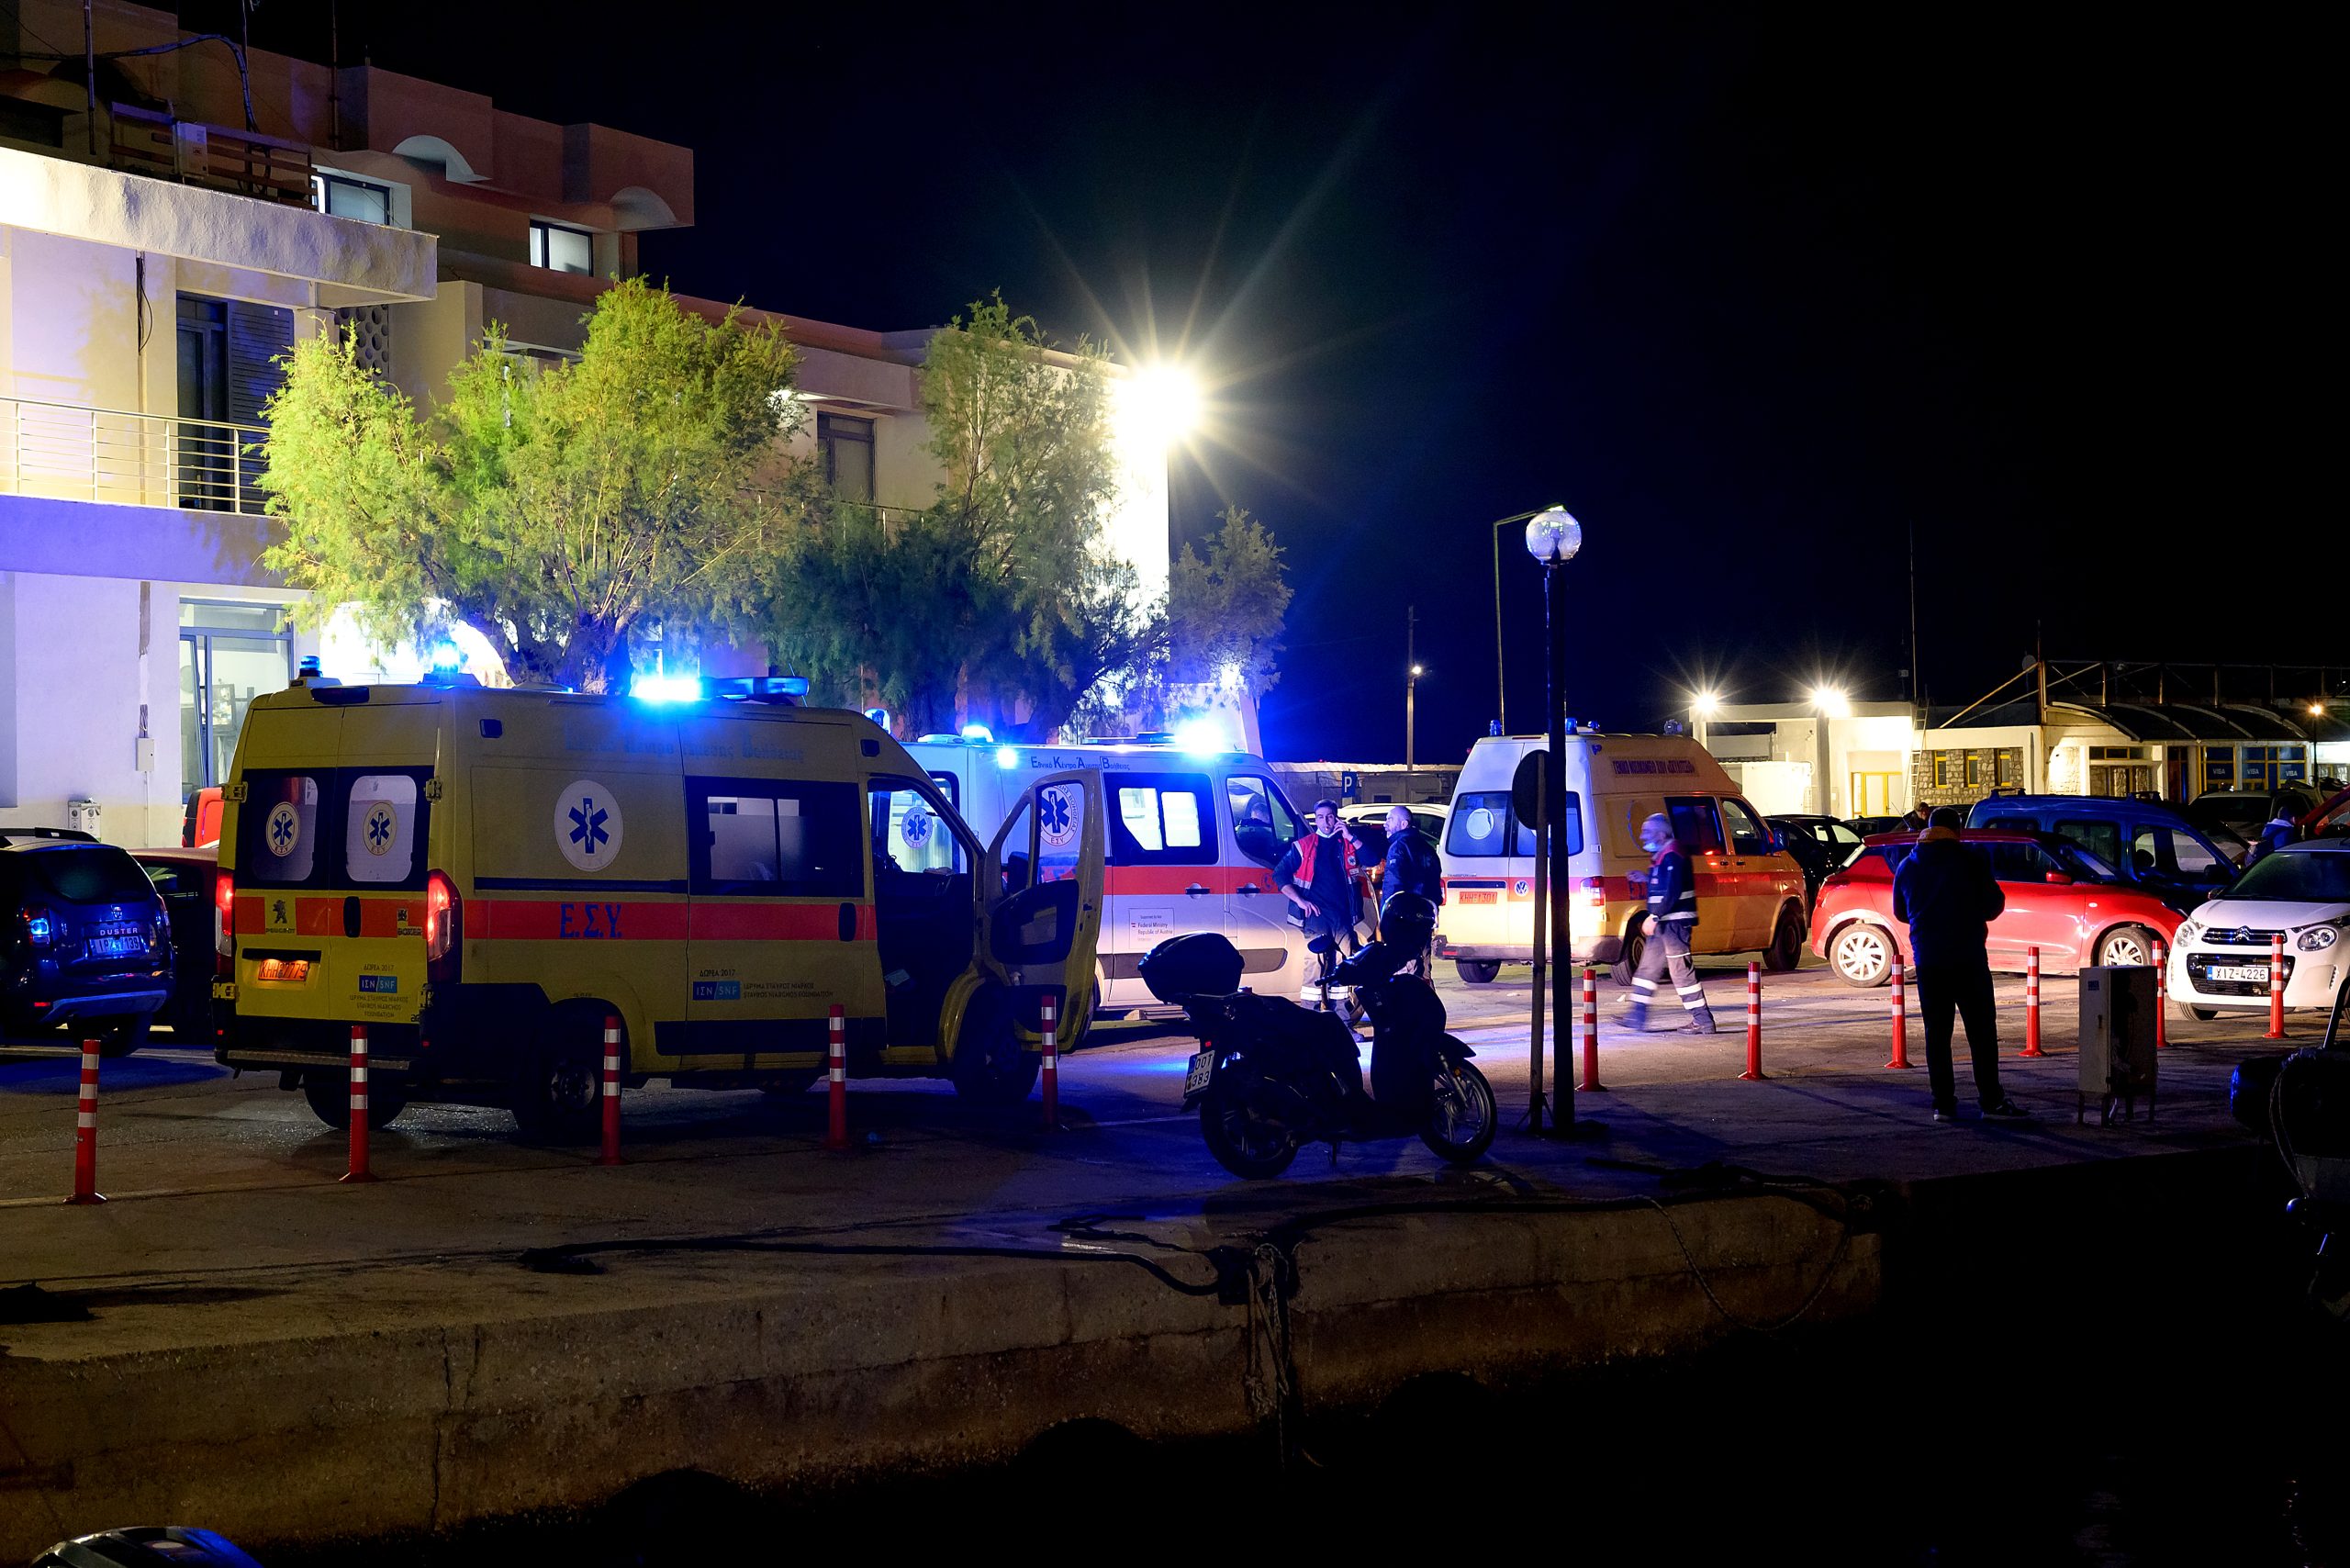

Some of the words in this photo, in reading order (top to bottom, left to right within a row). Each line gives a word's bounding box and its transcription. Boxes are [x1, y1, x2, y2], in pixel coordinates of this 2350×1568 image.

[1345, 776, 1352, 793] P
[100, 927, 138, 936] DUSTER
[2216, 968, 2266, 980] XIZ-4226
[1192, 1070, 1210, 1087] 383
